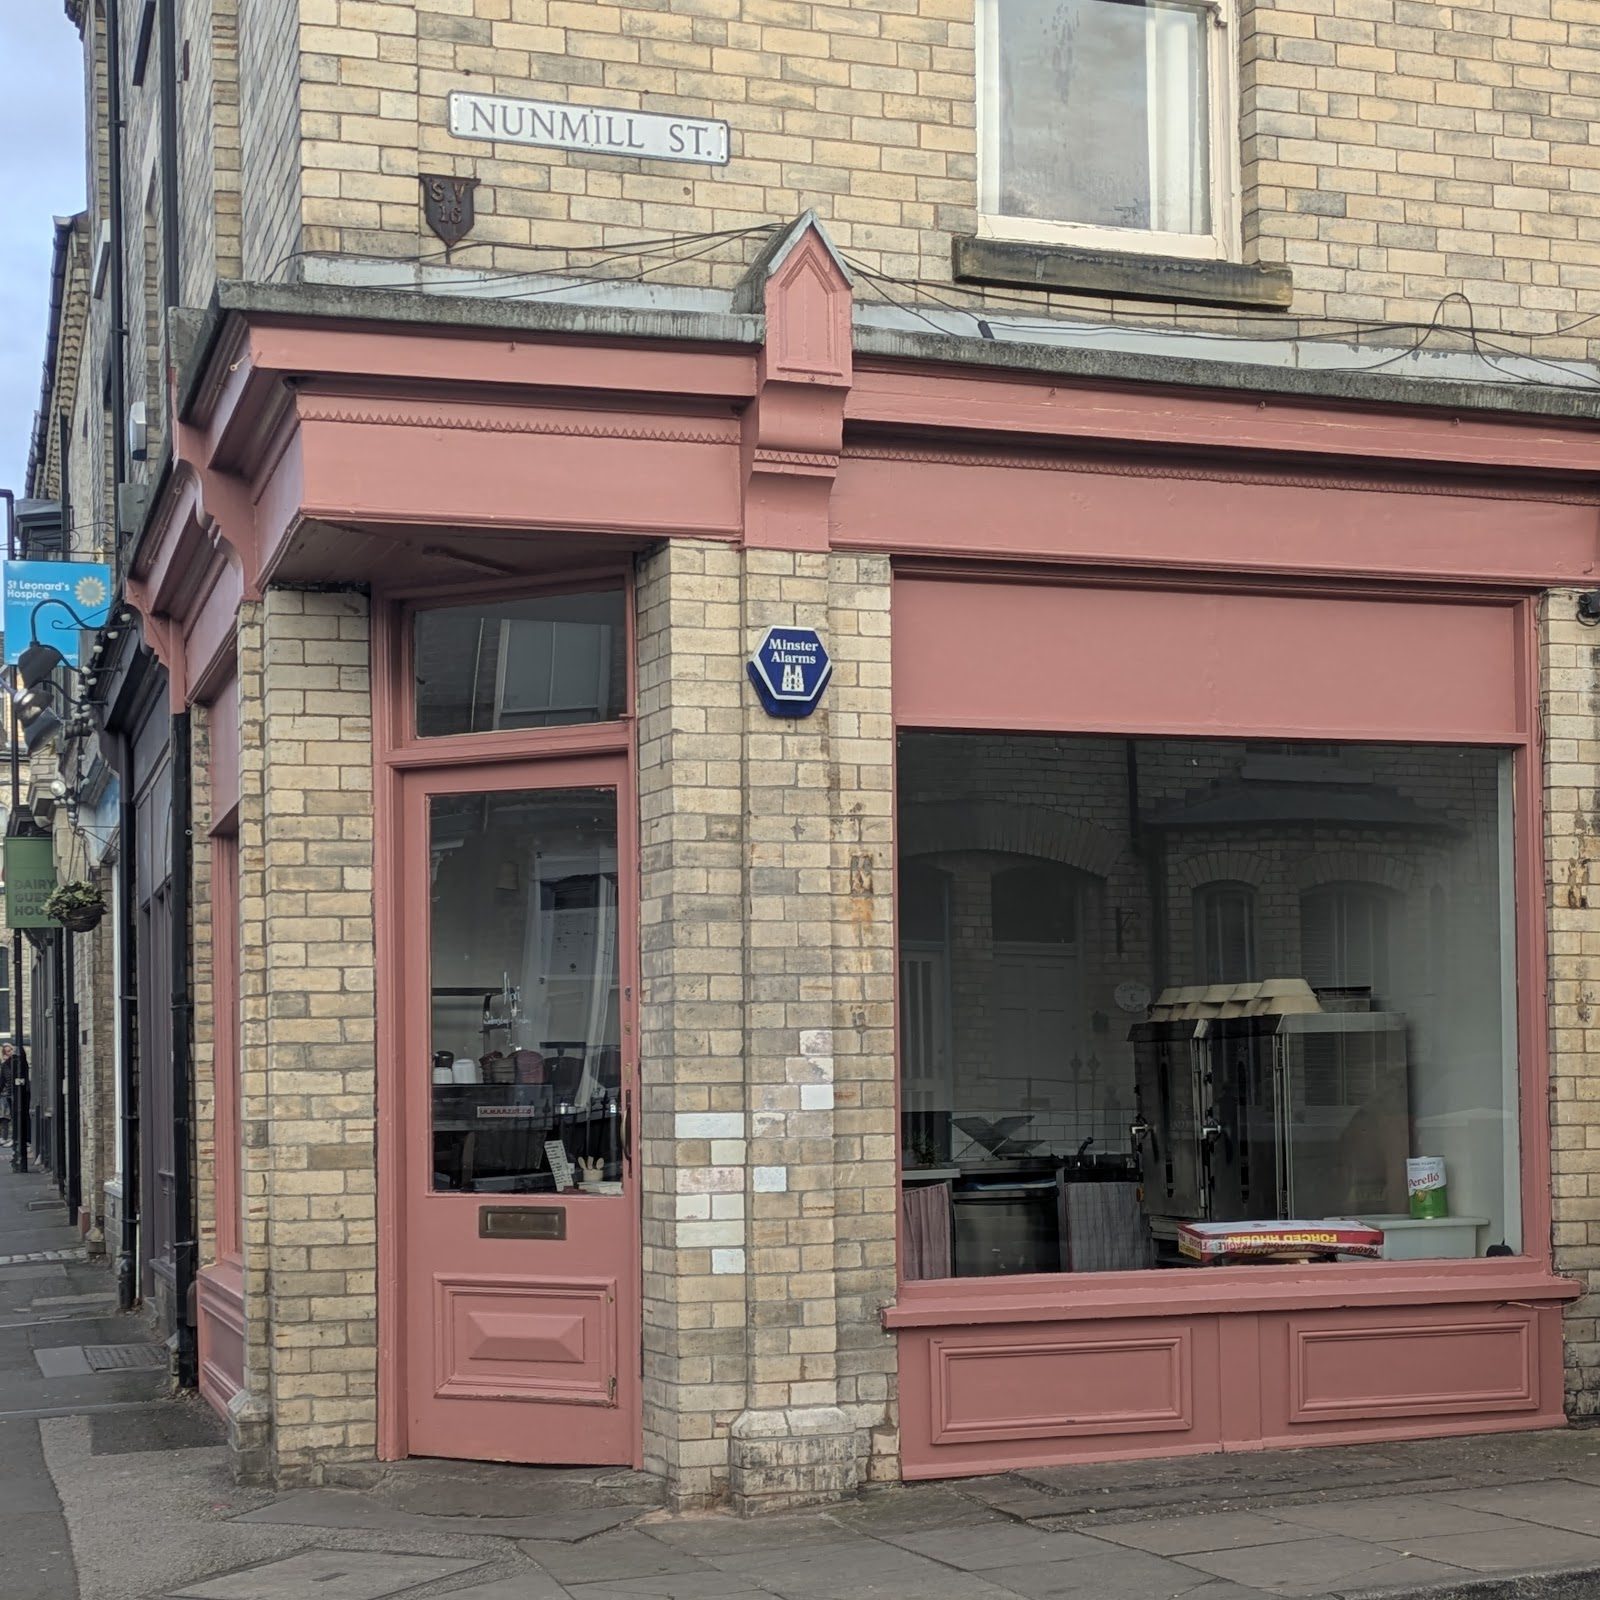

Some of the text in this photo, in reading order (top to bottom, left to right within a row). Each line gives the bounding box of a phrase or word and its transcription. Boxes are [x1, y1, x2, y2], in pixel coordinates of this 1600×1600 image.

[469, 101, 712, 156] NUNMILL ST.
[7, 580, 70, 592] St Leonard's
[7, 589, 50, 600] Hospice
[768, 638, 819, 652] Minster
[770, 651, 817, 665] Alarms
[15, 892, 50, 903] GUES
[15, 905, 45, 916] HOU
[1283, 1233, 1338, 1243] FORCED
